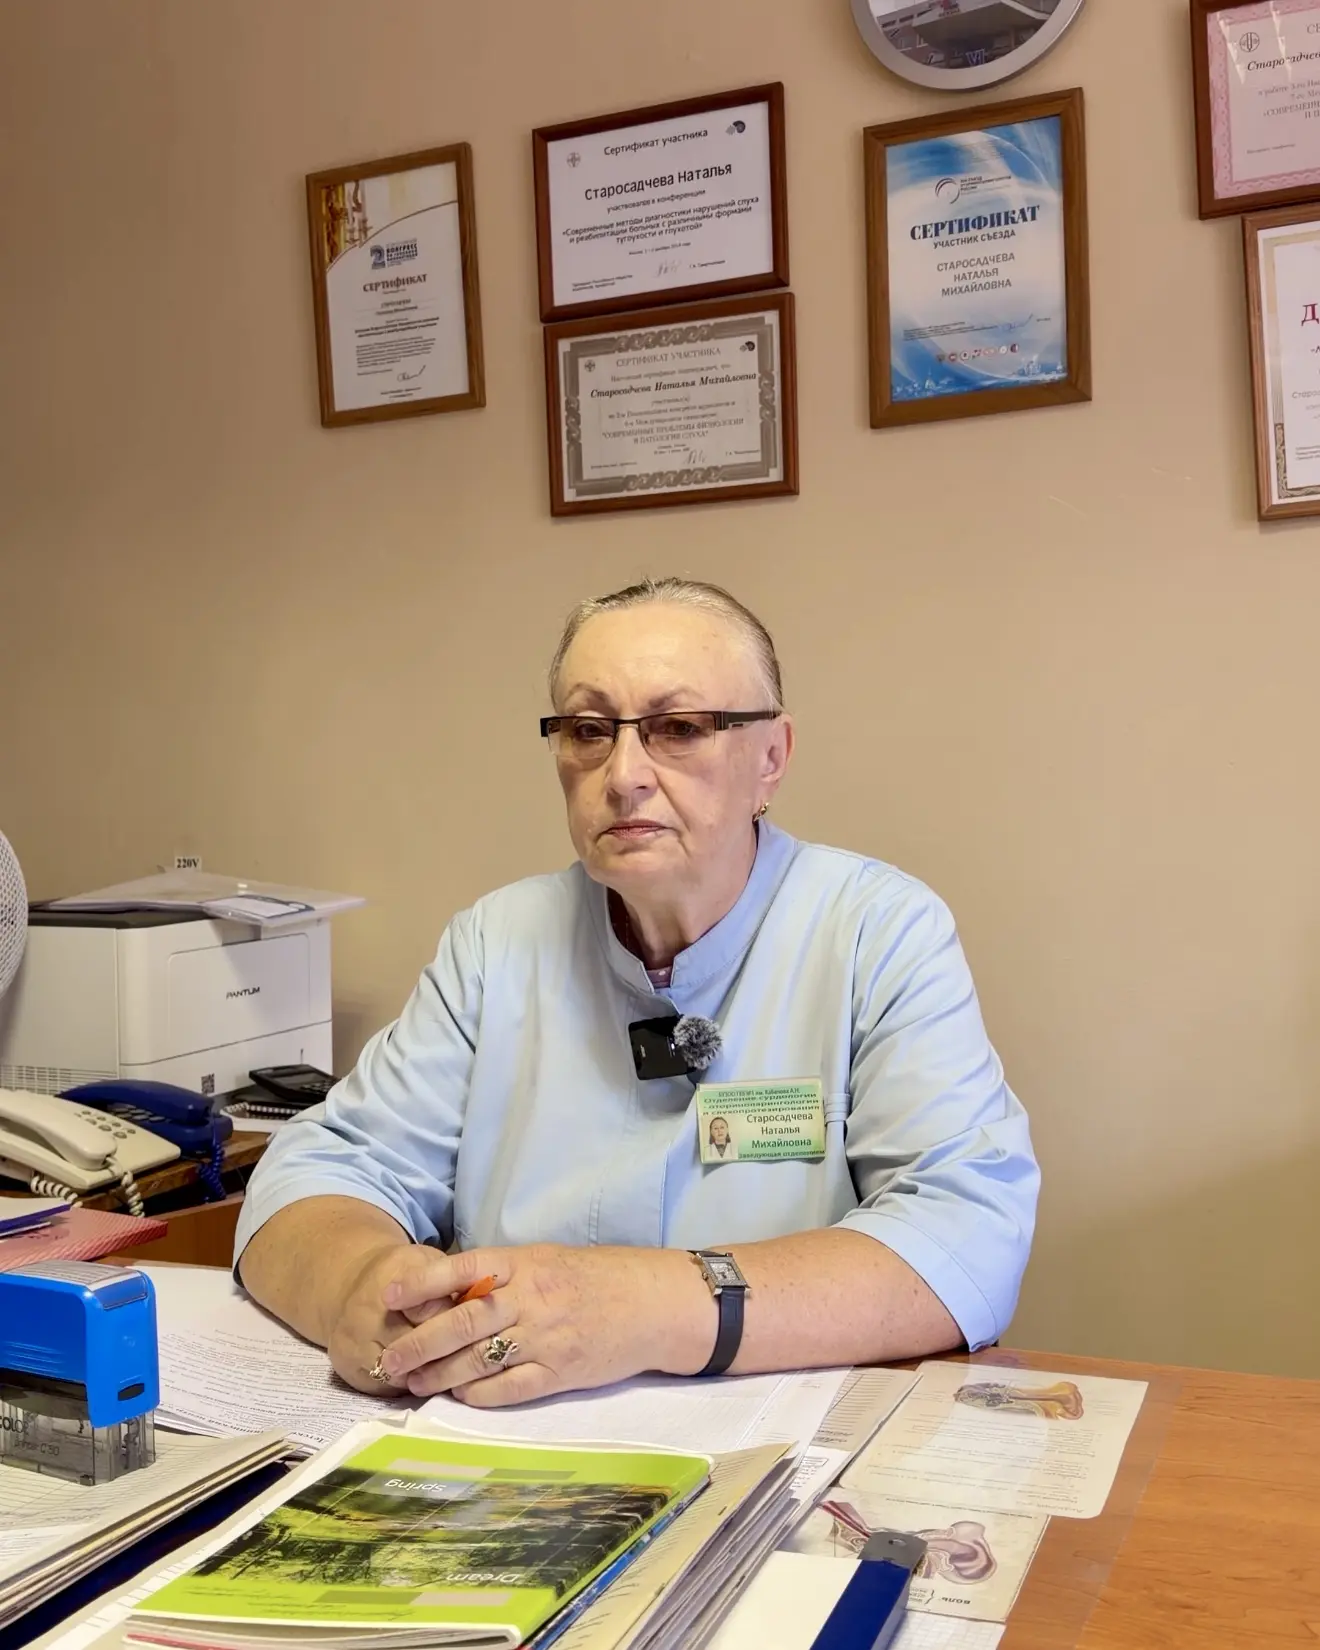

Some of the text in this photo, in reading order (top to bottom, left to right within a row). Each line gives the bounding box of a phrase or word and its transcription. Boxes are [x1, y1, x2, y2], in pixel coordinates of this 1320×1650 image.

[604, 129, 708, 156] Сертификат участника
[585, 163, 732, 200] Старосадчева Наталья
[657, 189, 706, 203] конференции
[616, 218, 643, 227] методы
[644, 209, 691, 224] диагностики
[693, 200, 736, 214] нарушений
[737, 197, 759, 206] слуха
[576, 229, 627, 244] реабилитации
[629, 222, 660, 233] больных
[715, 206, 752, 219] формами
[910, 205, 1040, 241] СЕРТИФИКАТ
[616, 230, 656, 245] тугоухости
[933, 229, 1016, 249] УЧАСТНИК СЪЕЗДА
[936, 252, 1015, 272] СТАРОСАДЧЕВА
[363, 273, 428, 292] СЕРТИФИКАТ
[953, 267, 999, 282] НАТАЛЬЯ
[941, 279, 1012, 297] МИХАЙЛОВНА
[616, 347, 721, 367] СЕРТИФИКАТ УЧАСТНИКА
[590, 373, 757, 399] Старосадчева Наталья Михайловна
[176, 858, 200, 869] 220V
[226, 986, 261, 1000] PANTUM
[746, 1113, 813, 1124] Старосадчева
[761, 1126, 801, 1136] Наталья
[751, 1138, 812, 1149] Михайловна
[446, 1573, 521, 1583] Dream
